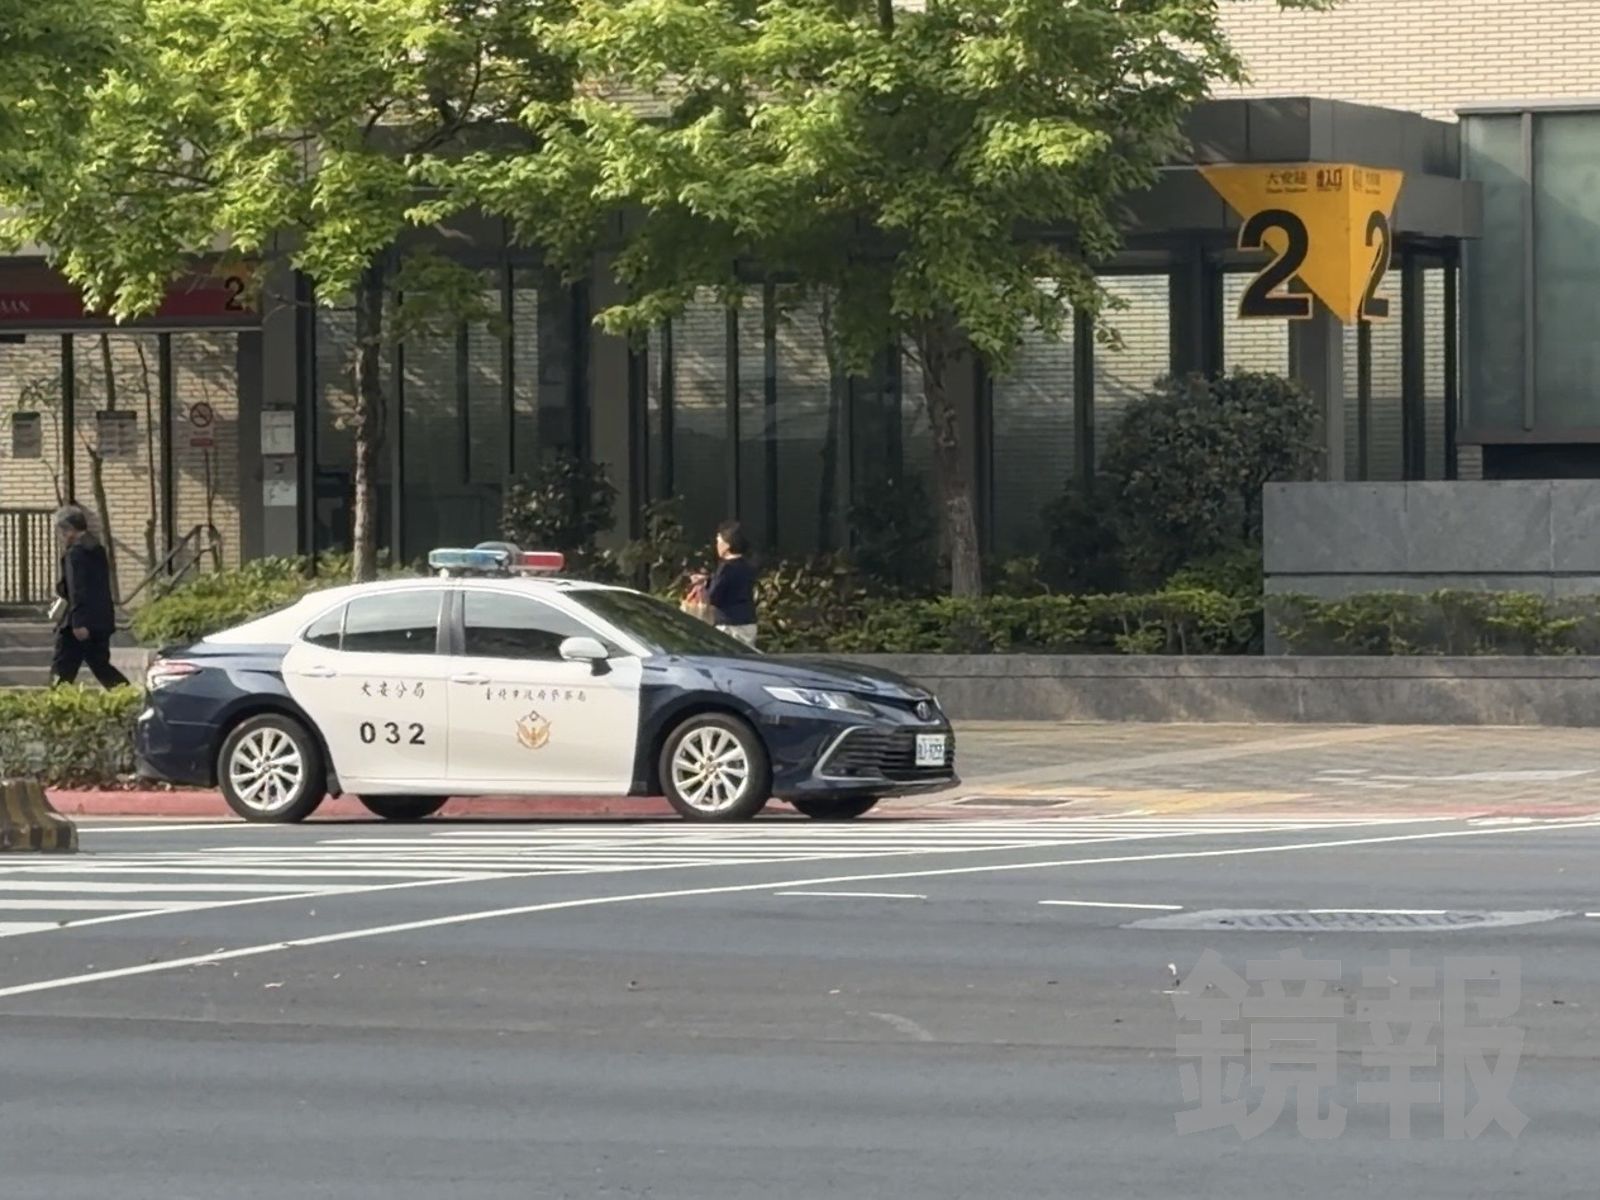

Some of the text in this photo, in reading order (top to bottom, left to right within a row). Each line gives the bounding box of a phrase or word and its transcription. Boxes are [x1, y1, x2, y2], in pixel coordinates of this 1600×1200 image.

[225, 276, 246, 312] 2
[1239, 208, 1311, 318] 2
[1363, 209, 1391, 318] 2
[360, 721, 426, 745] 032
